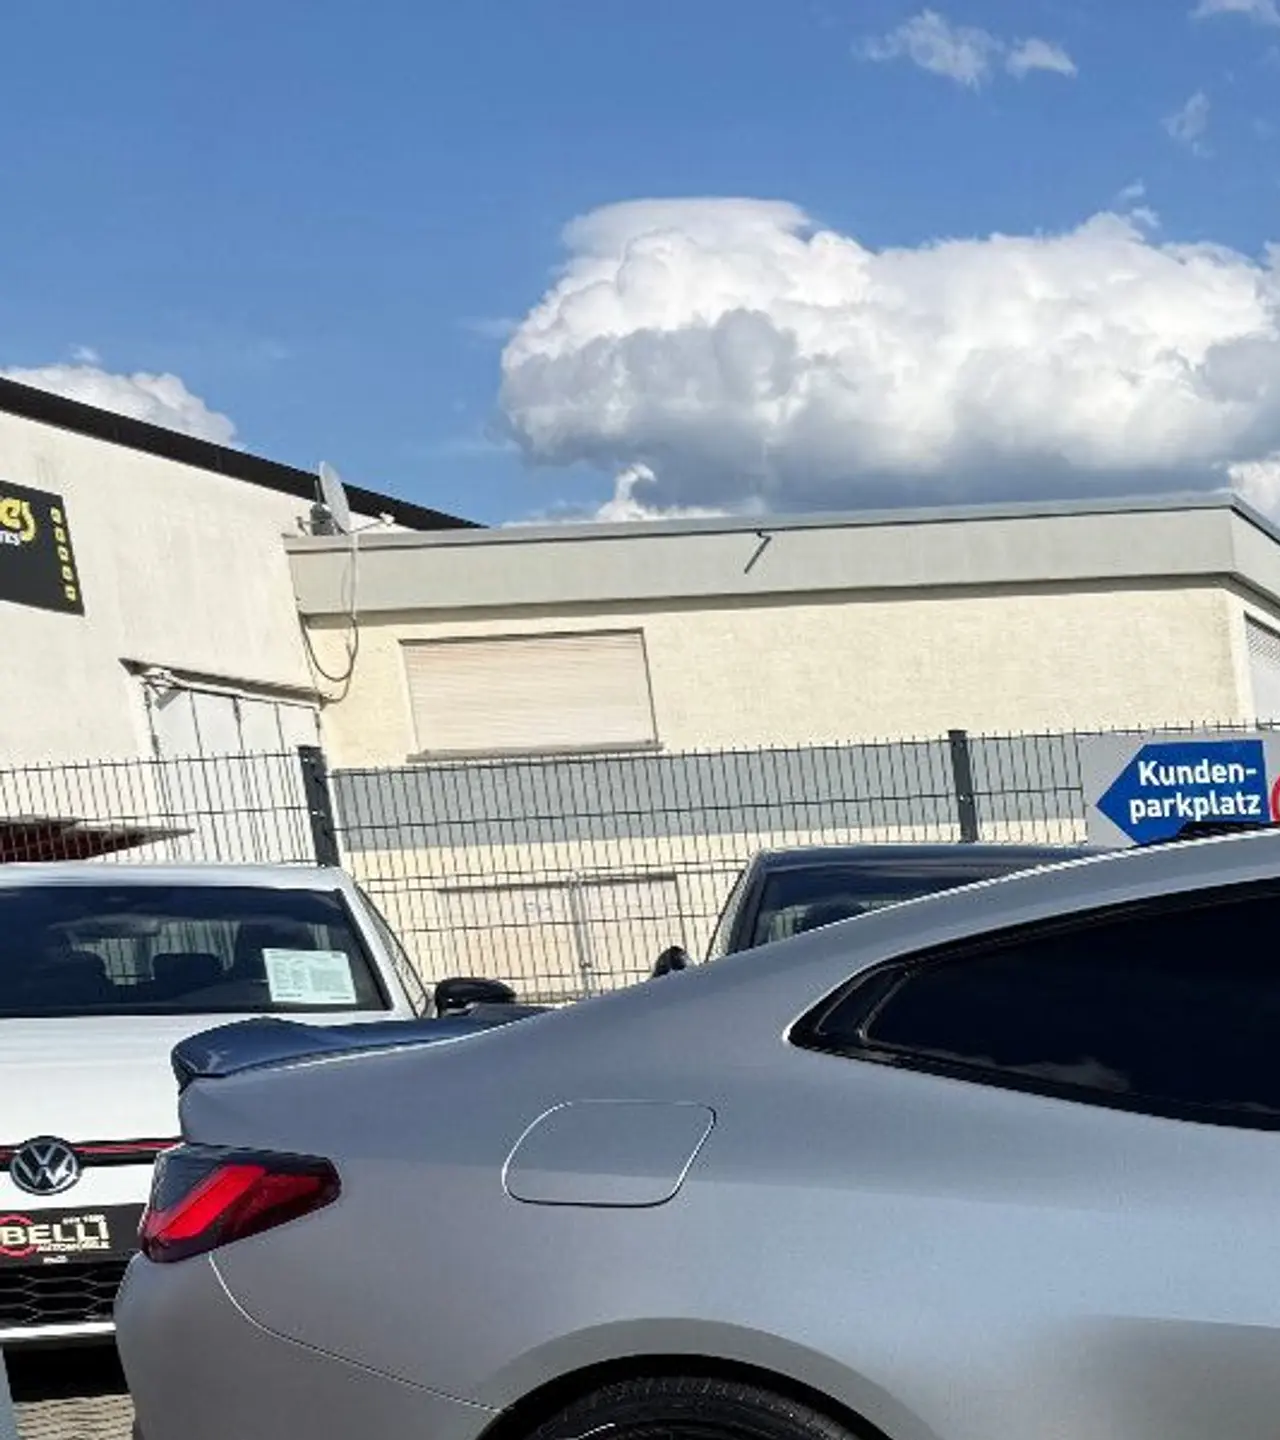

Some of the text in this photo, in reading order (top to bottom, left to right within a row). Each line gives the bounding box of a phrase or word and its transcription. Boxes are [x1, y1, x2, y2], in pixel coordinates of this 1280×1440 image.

[1138, 758, 1257, 786] Kunden-
[1129, 789, 1262, 825] parkplatz
[0, 1222, 110, 1246] BELLI
